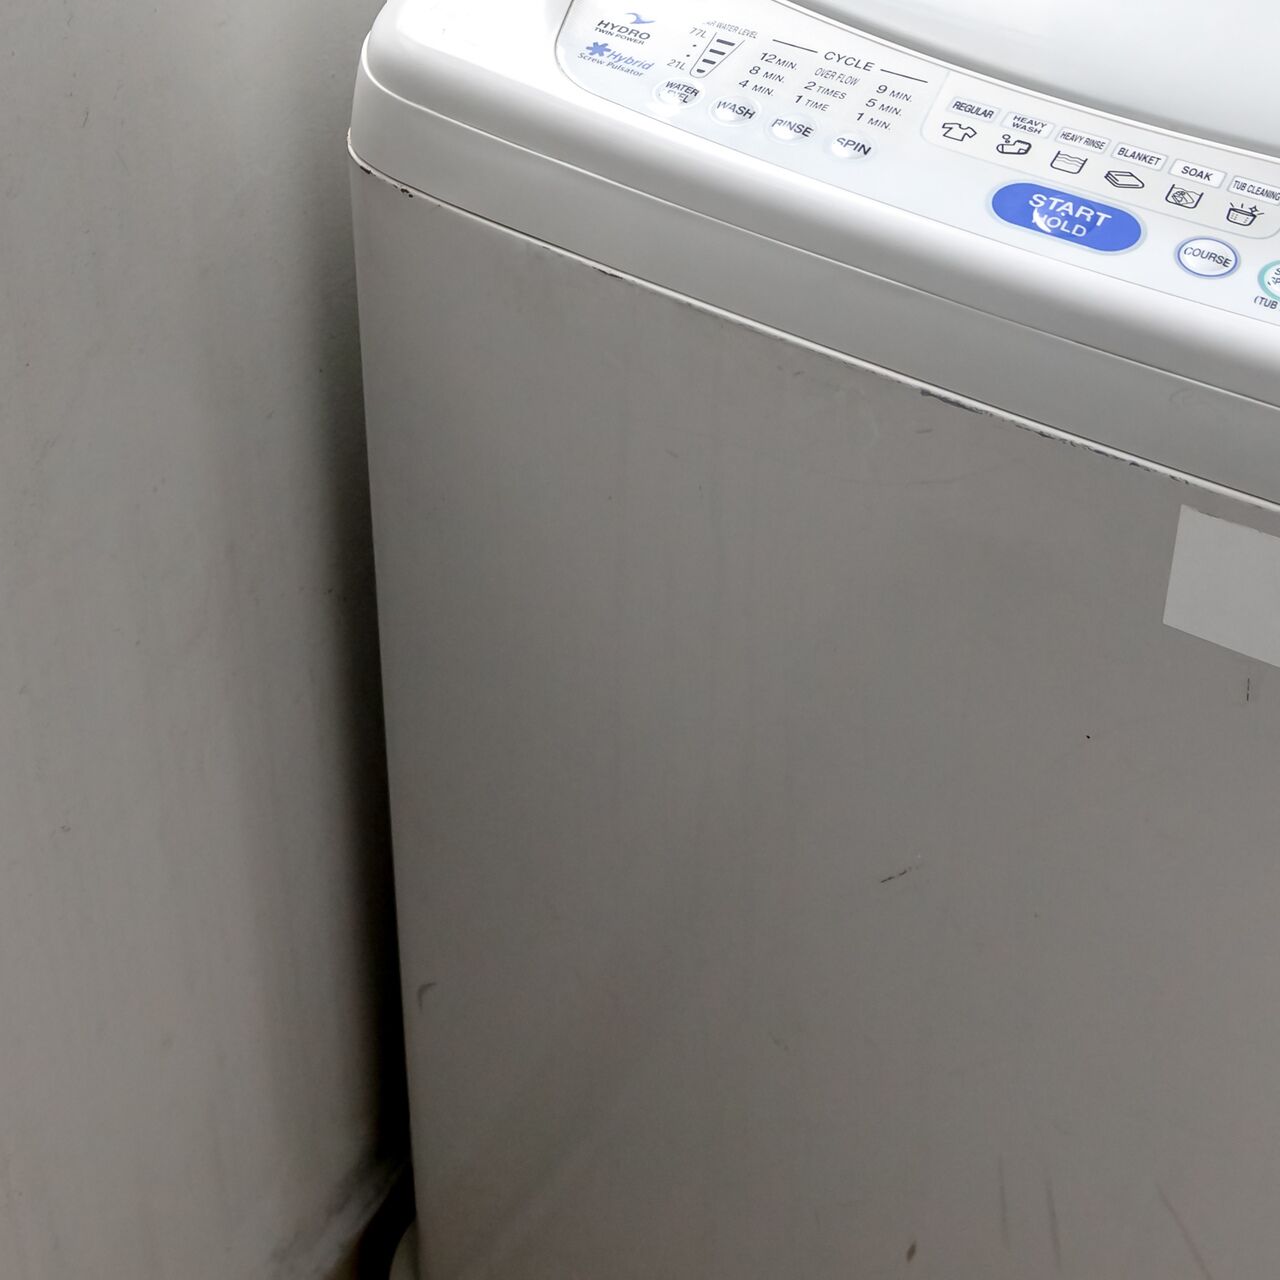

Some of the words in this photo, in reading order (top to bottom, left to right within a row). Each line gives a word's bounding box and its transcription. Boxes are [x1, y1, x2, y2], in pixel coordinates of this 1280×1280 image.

[594, 27, 614, 37] TWIN
[615, 33, 645, 45] POWER
[597, 20, 651, 40] HYDRO
[689, 27, 707, 39] 77L
[577, 52, 605, 66] Screw
[606, 61, 645, 78] Pulsator
[607, 50, 655, 71] Hybrid
[667, 59, 686, 71] 21L
[823, 51, 875, 72] CYCLE
[749, 66, 761, 75] 8
[762, 71, 785, 84] MIN.
[814, 68, 837, 80] OVER
[837, 74, 861, 87] FLOW
[665, 81, 700, 97] WATER
[738, 79, 750, 89] 4
[751, 84, 774, 97] MIN.
[804, 81, 817, 91] 2
[816, 85, 847, 100] TIMES
[875, 84, 888, 94] 9
[889, 90, 913, 103] MIN.
[716, 101, 756, 119] WASH
[794, 95, 803, 104] 1
[805, 99, 830, 112] TIME
[865, 98, 878, 108] 5
[878, 104, 902, 117] MIN.
[952, 100, 994, 119] REGULAR
[856, 112, 865, 121] 1
[867, 118, 891, 131] MIN.
[1011, 122, 1042, 135] WASH
[1012, 115, 1048, 129] HEAVY
[836, 137, 872, 156] SPIN
[1060, 131, 1085, 143] HEAVY
[1085, 137, 1106, 150] RINSE
[1117, 147, 1162, 166] BLANKET
[1181, 166, 1214, 182] SOAK
[1232, 180, 1247, 191] TUB
[1029, 193, 1112, 227] START
[1183, 247, 1233, 268] COURSE
[1253, 295, 1278, 309] (TUB
